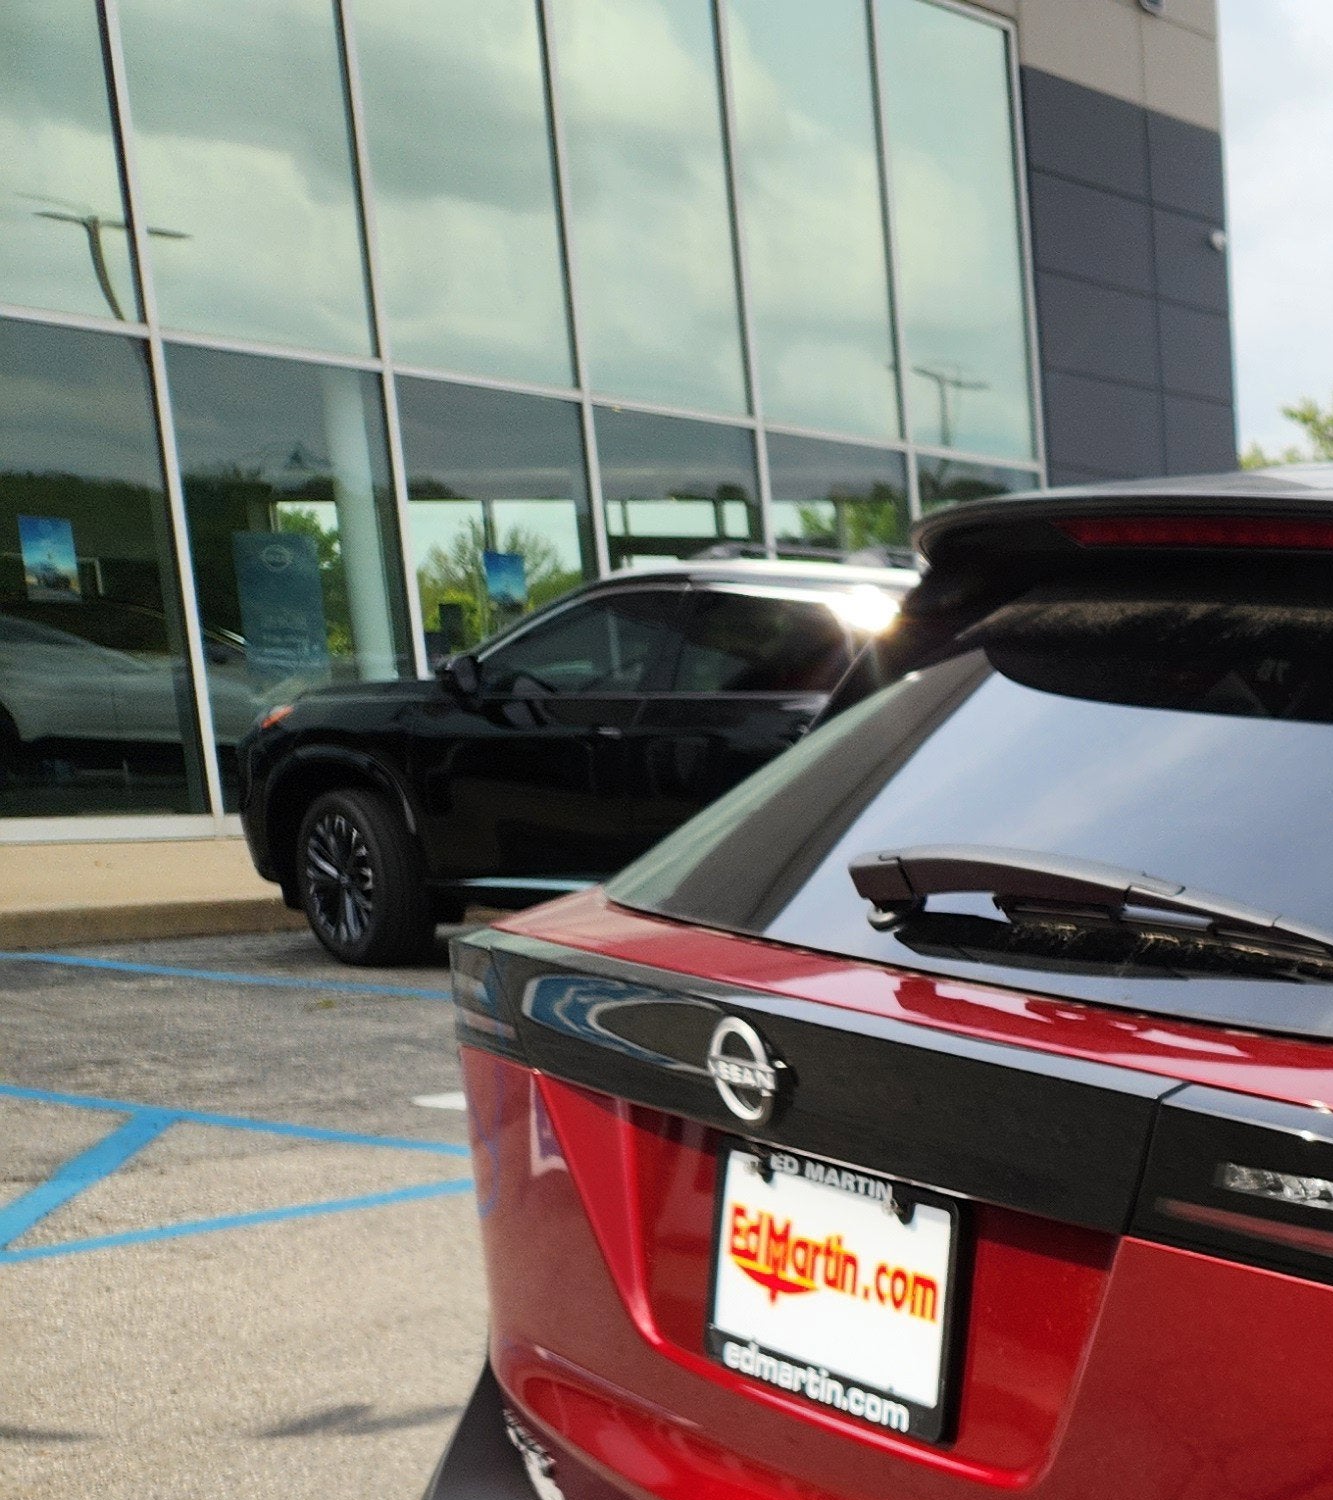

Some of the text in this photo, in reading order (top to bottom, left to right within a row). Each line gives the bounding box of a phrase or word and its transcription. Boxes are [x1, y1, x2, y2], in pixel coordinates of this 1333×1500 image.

[770, 1152, 893, 1202] ED MARTIN
[729, 1202, 939, 1323] EdMartin.com
[722, 1340, 910, 1433] edmartin.com
